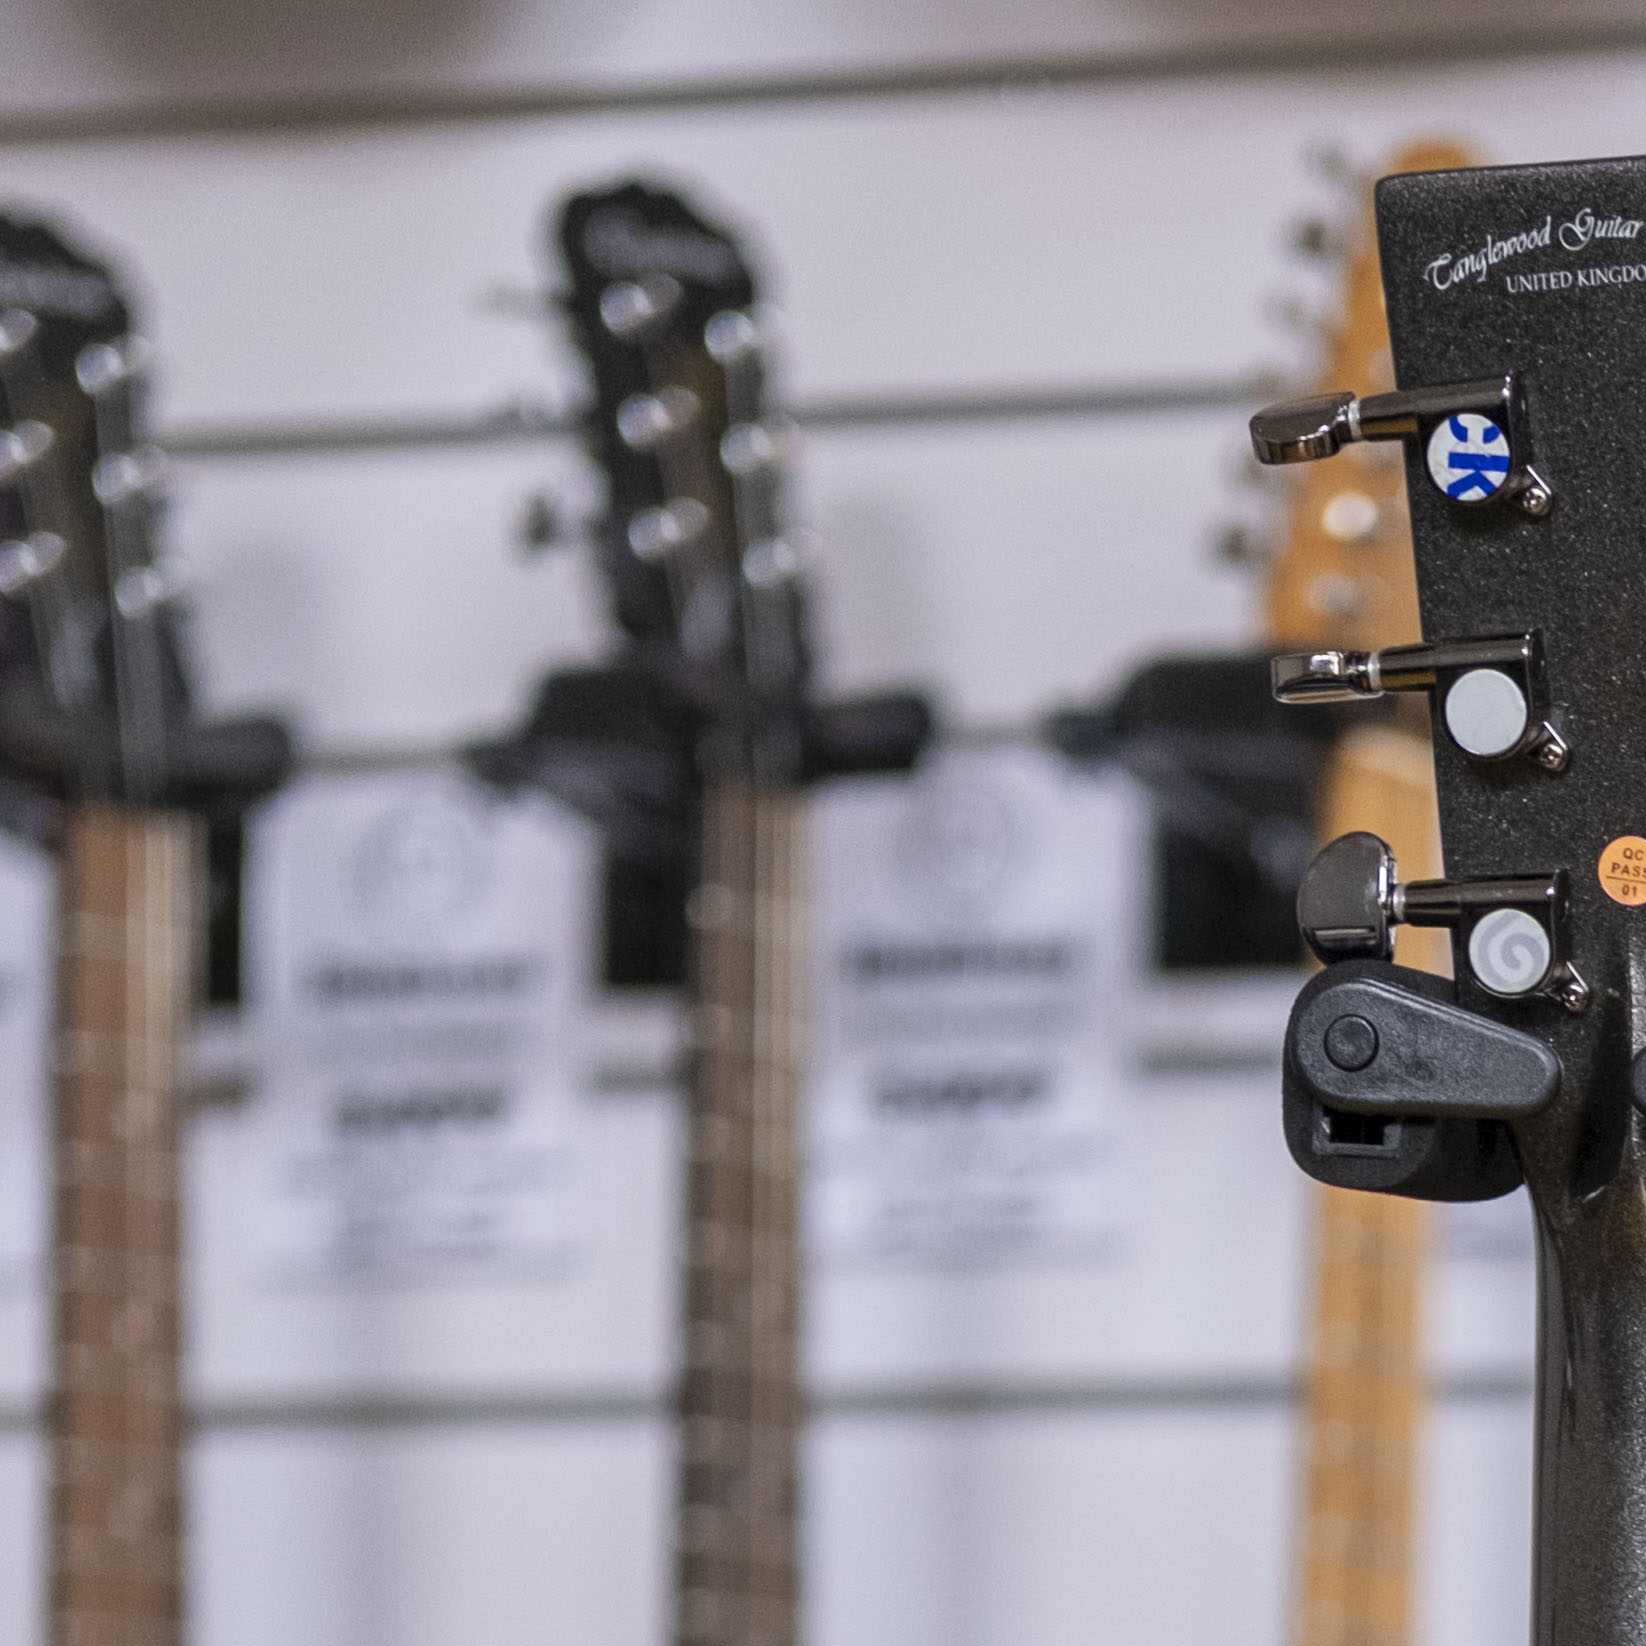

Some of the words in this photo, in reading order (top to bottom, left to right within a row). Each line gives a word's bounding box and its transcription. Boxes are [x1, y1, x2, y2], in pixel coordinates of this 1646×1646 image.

[1424, 215, 1552, 291] Tanglewood
[1558, 207, 1644, 251] Guitar
[1506, 271, 1572, 293] UNITED
[1623, 848, 1644, 861] QC
